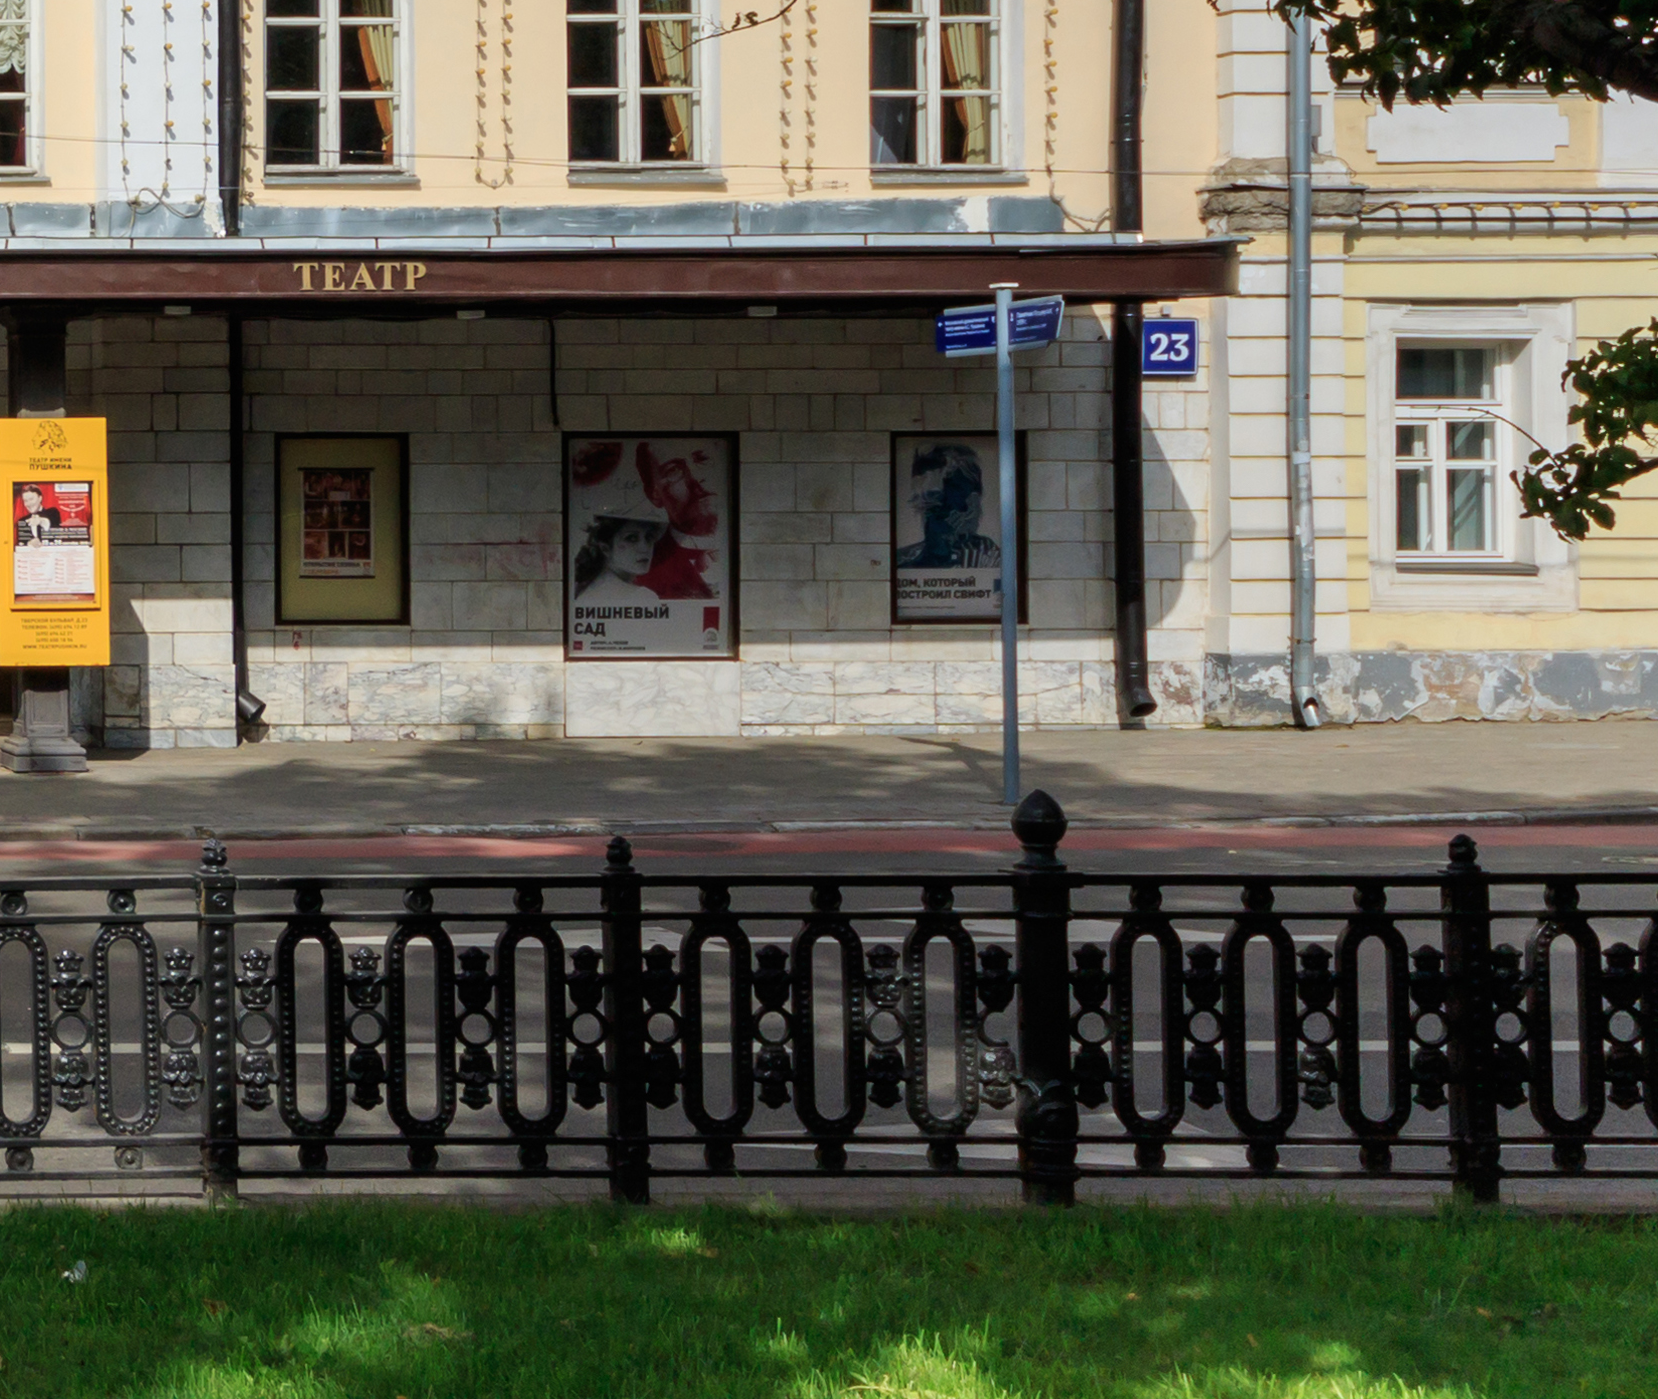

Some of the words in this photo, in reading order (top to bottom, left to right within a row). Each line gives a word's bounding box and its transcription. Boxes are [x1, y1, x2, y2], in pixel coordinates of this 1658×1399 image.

[293, 262, 427, 291] ТЕАТР
[1150, 332, 1190, 362] 23
[923, 575, 976, 588] КОТОРЫЙ
[953, 589, 992, 599] СВИФТ
[575, 604, 669, 619] ВИШНЕВЫЙ
[574, 622, 606, 637] САД
